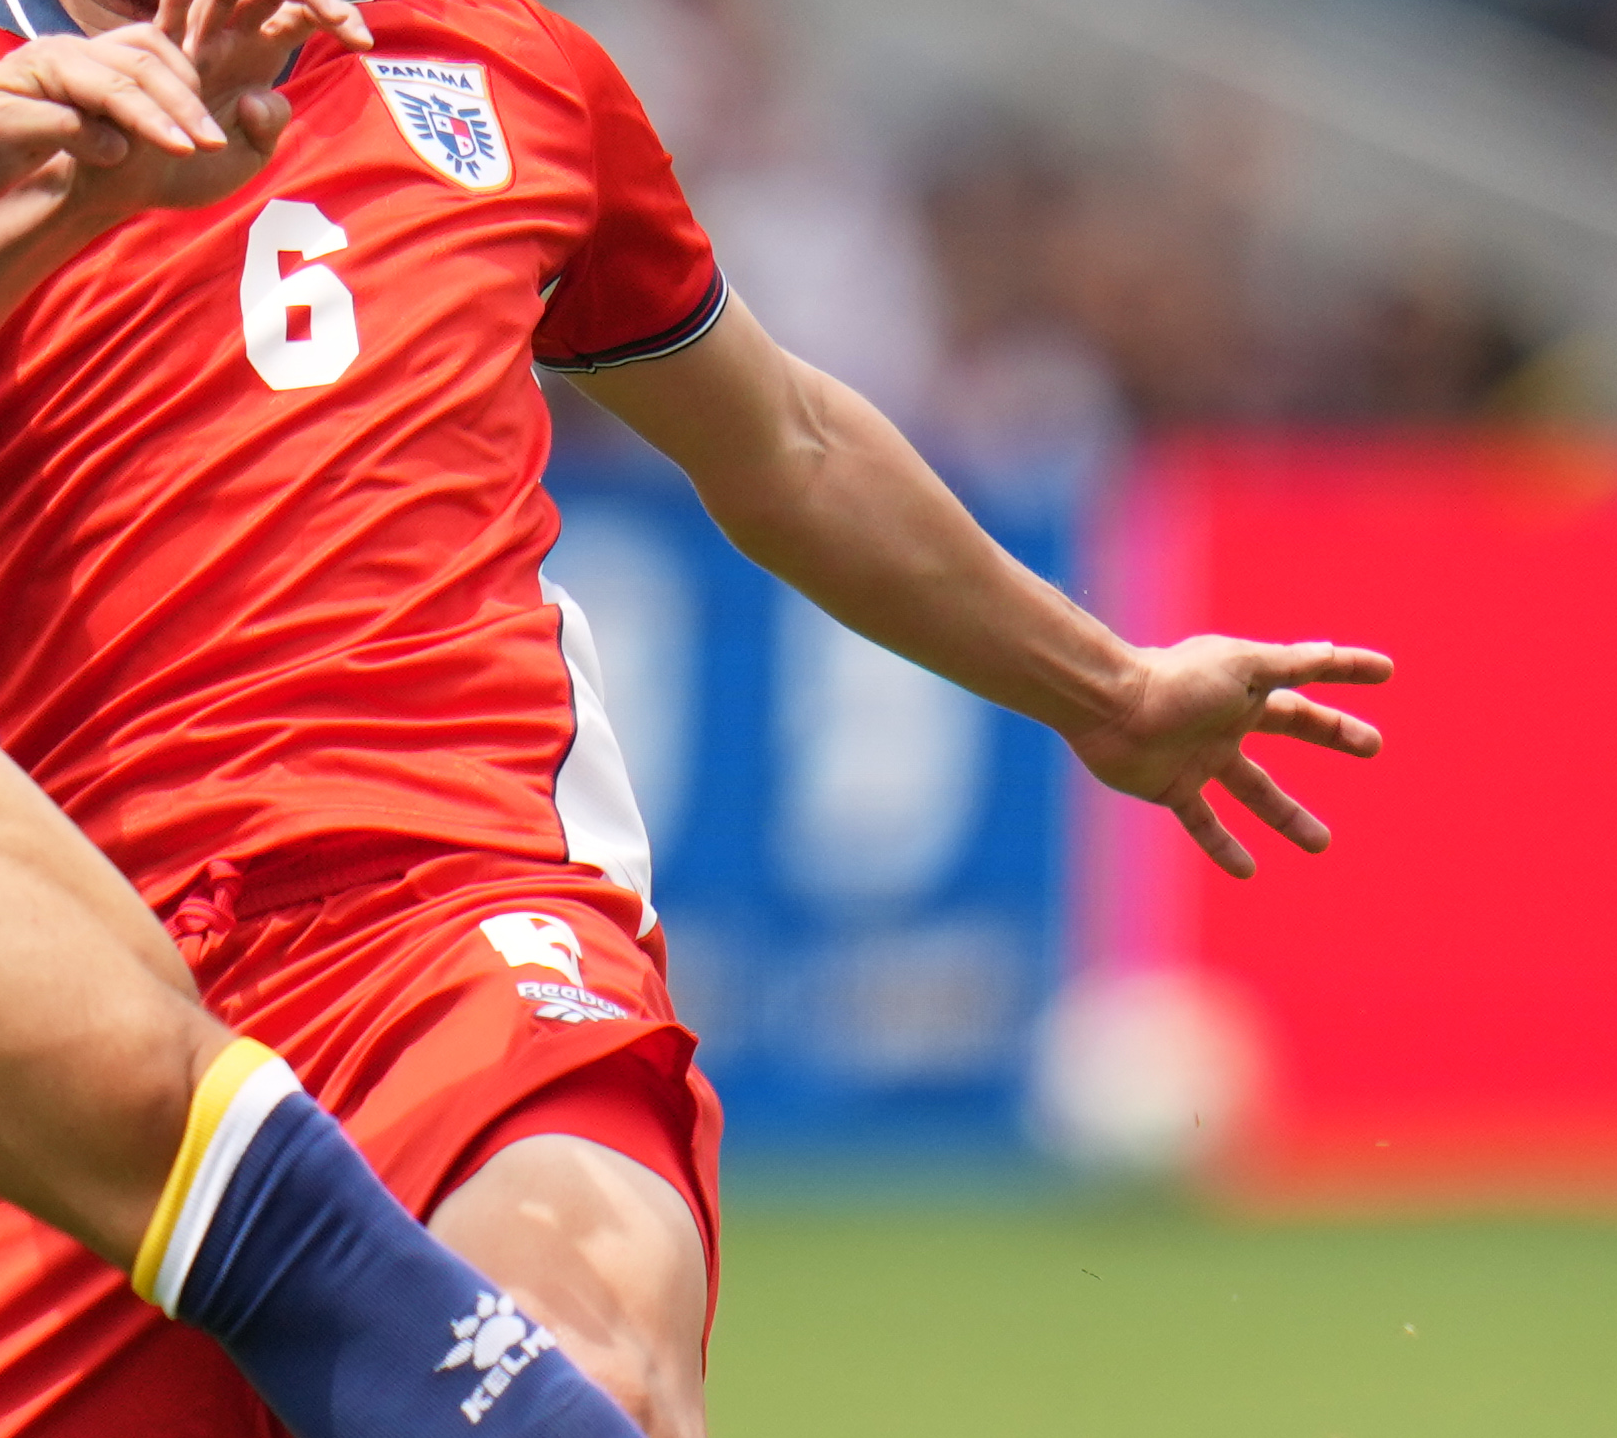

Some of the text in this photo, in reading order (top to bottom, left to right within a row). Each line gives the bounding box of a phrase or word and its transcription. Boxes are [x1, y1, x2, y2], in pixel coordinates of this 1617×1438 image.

[376, 64, 474, 91] PANAMÁ
[240, 198, 360, 391] 6
[516, 981, 628, 1020] Reebok
[460, 1325, 558, 1425] KELM
